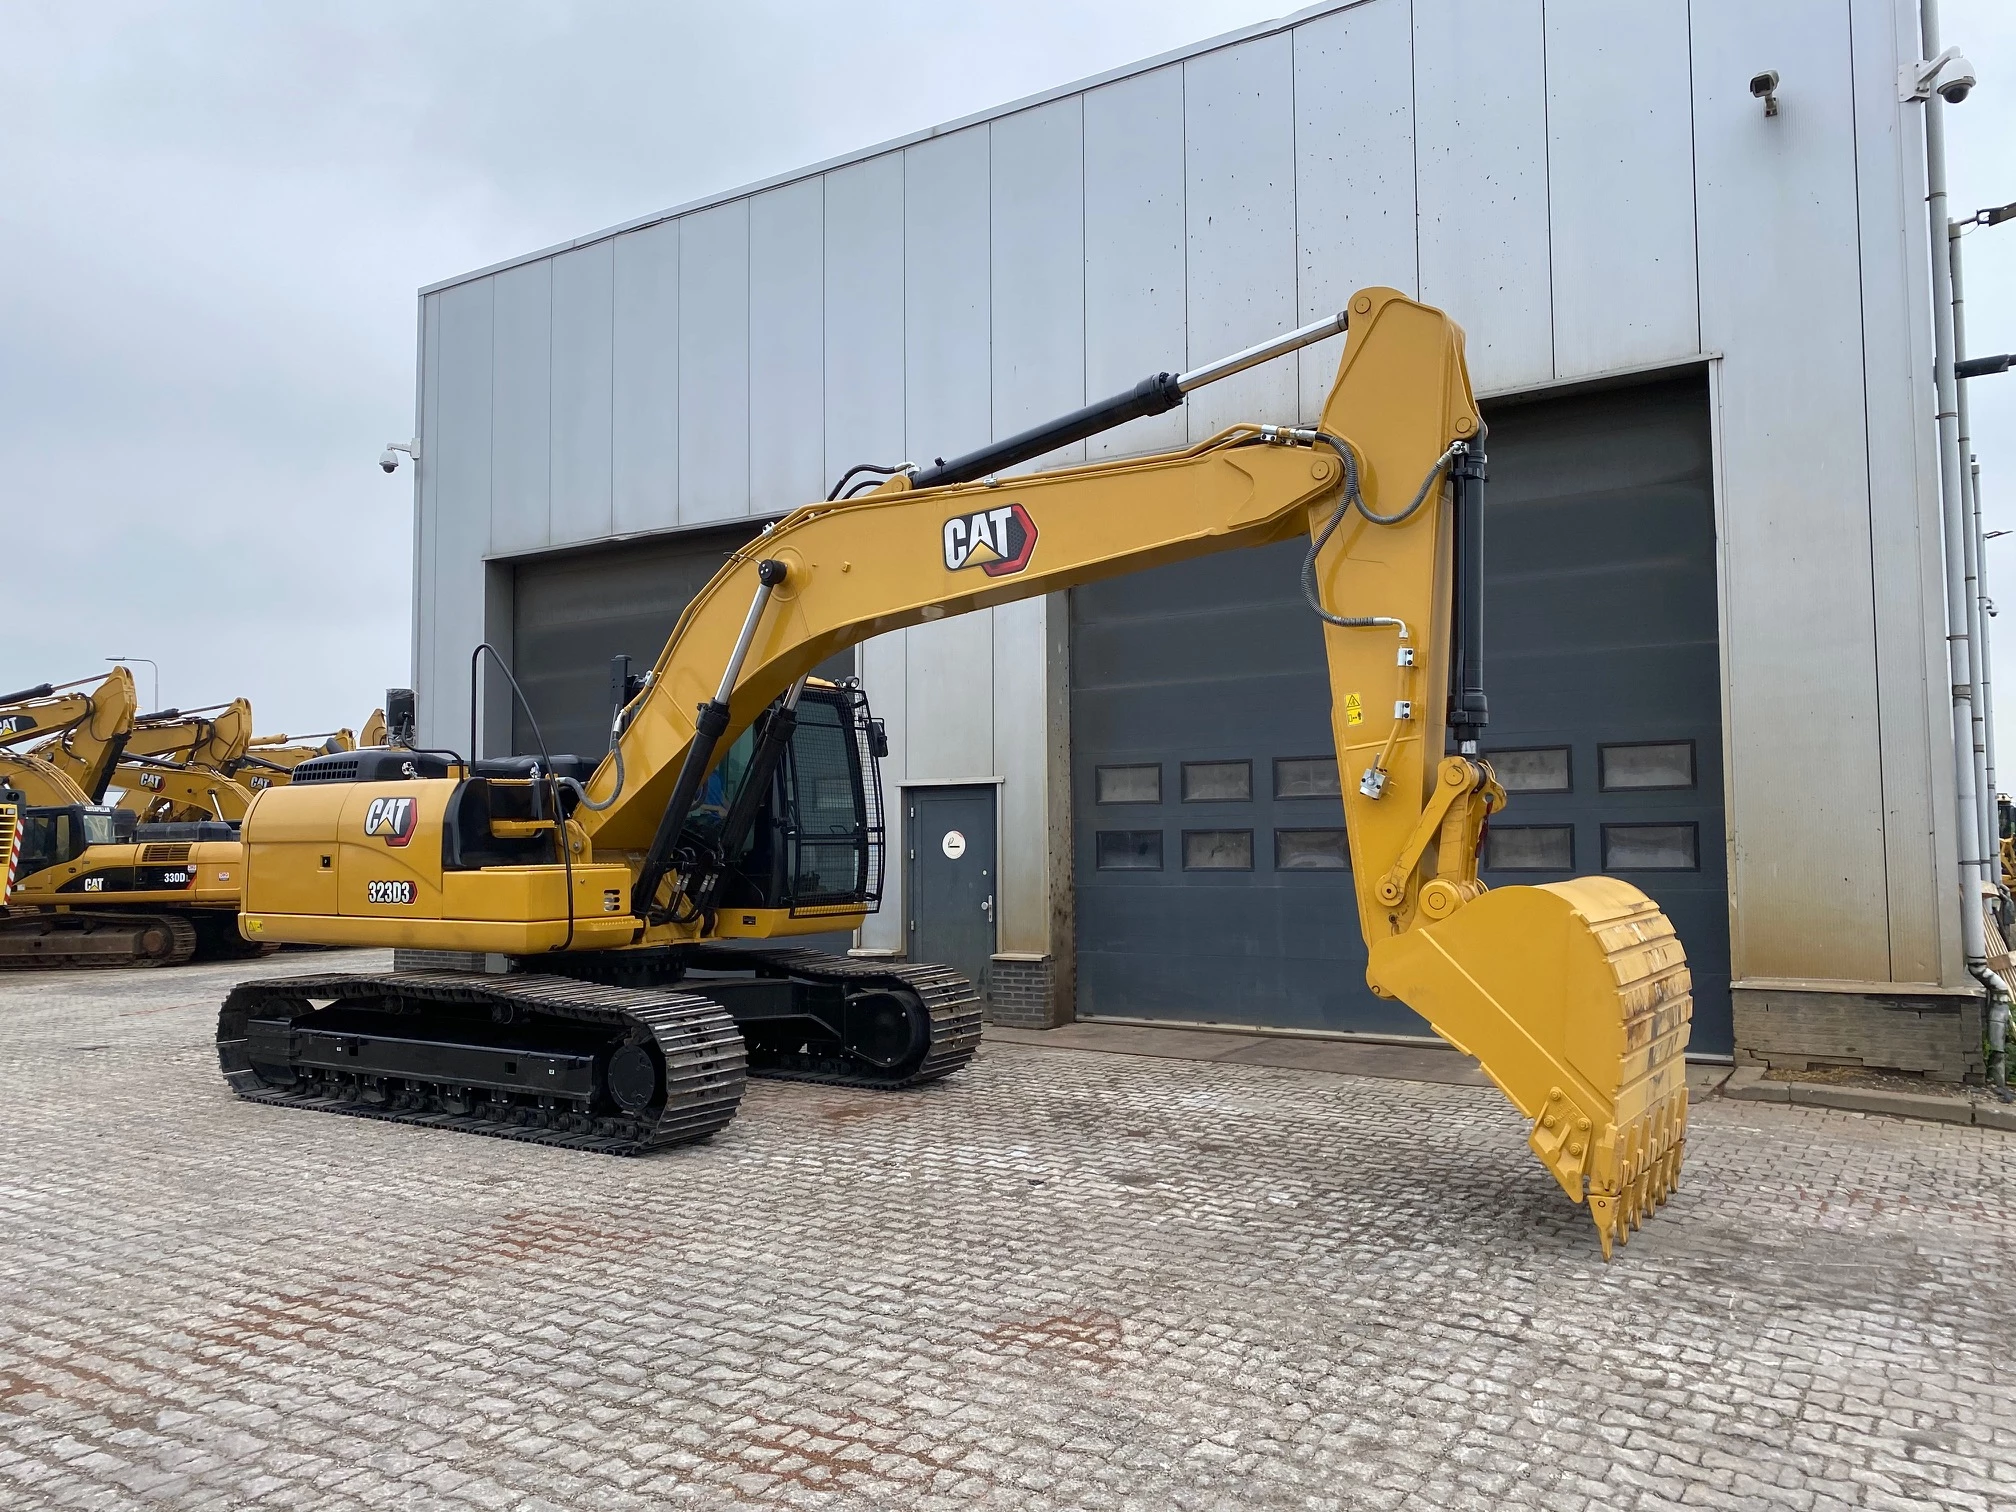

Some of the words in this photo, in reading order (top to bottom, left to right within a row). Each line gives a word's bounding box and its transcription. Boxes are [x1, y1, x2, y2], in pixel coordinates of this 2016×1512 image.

[944, 506, 1012, 570] CAT
[0, 716, 17, 736] AT
[140, 772, 162, 789] CAT
[250, 776, 270, 788] CAT
[365, 798, 411, 835] CAT
[84, 877, 104, 892] CAT
[164, 872, 185, 882] 330D
[368, 881, 410, 902] 323D3
